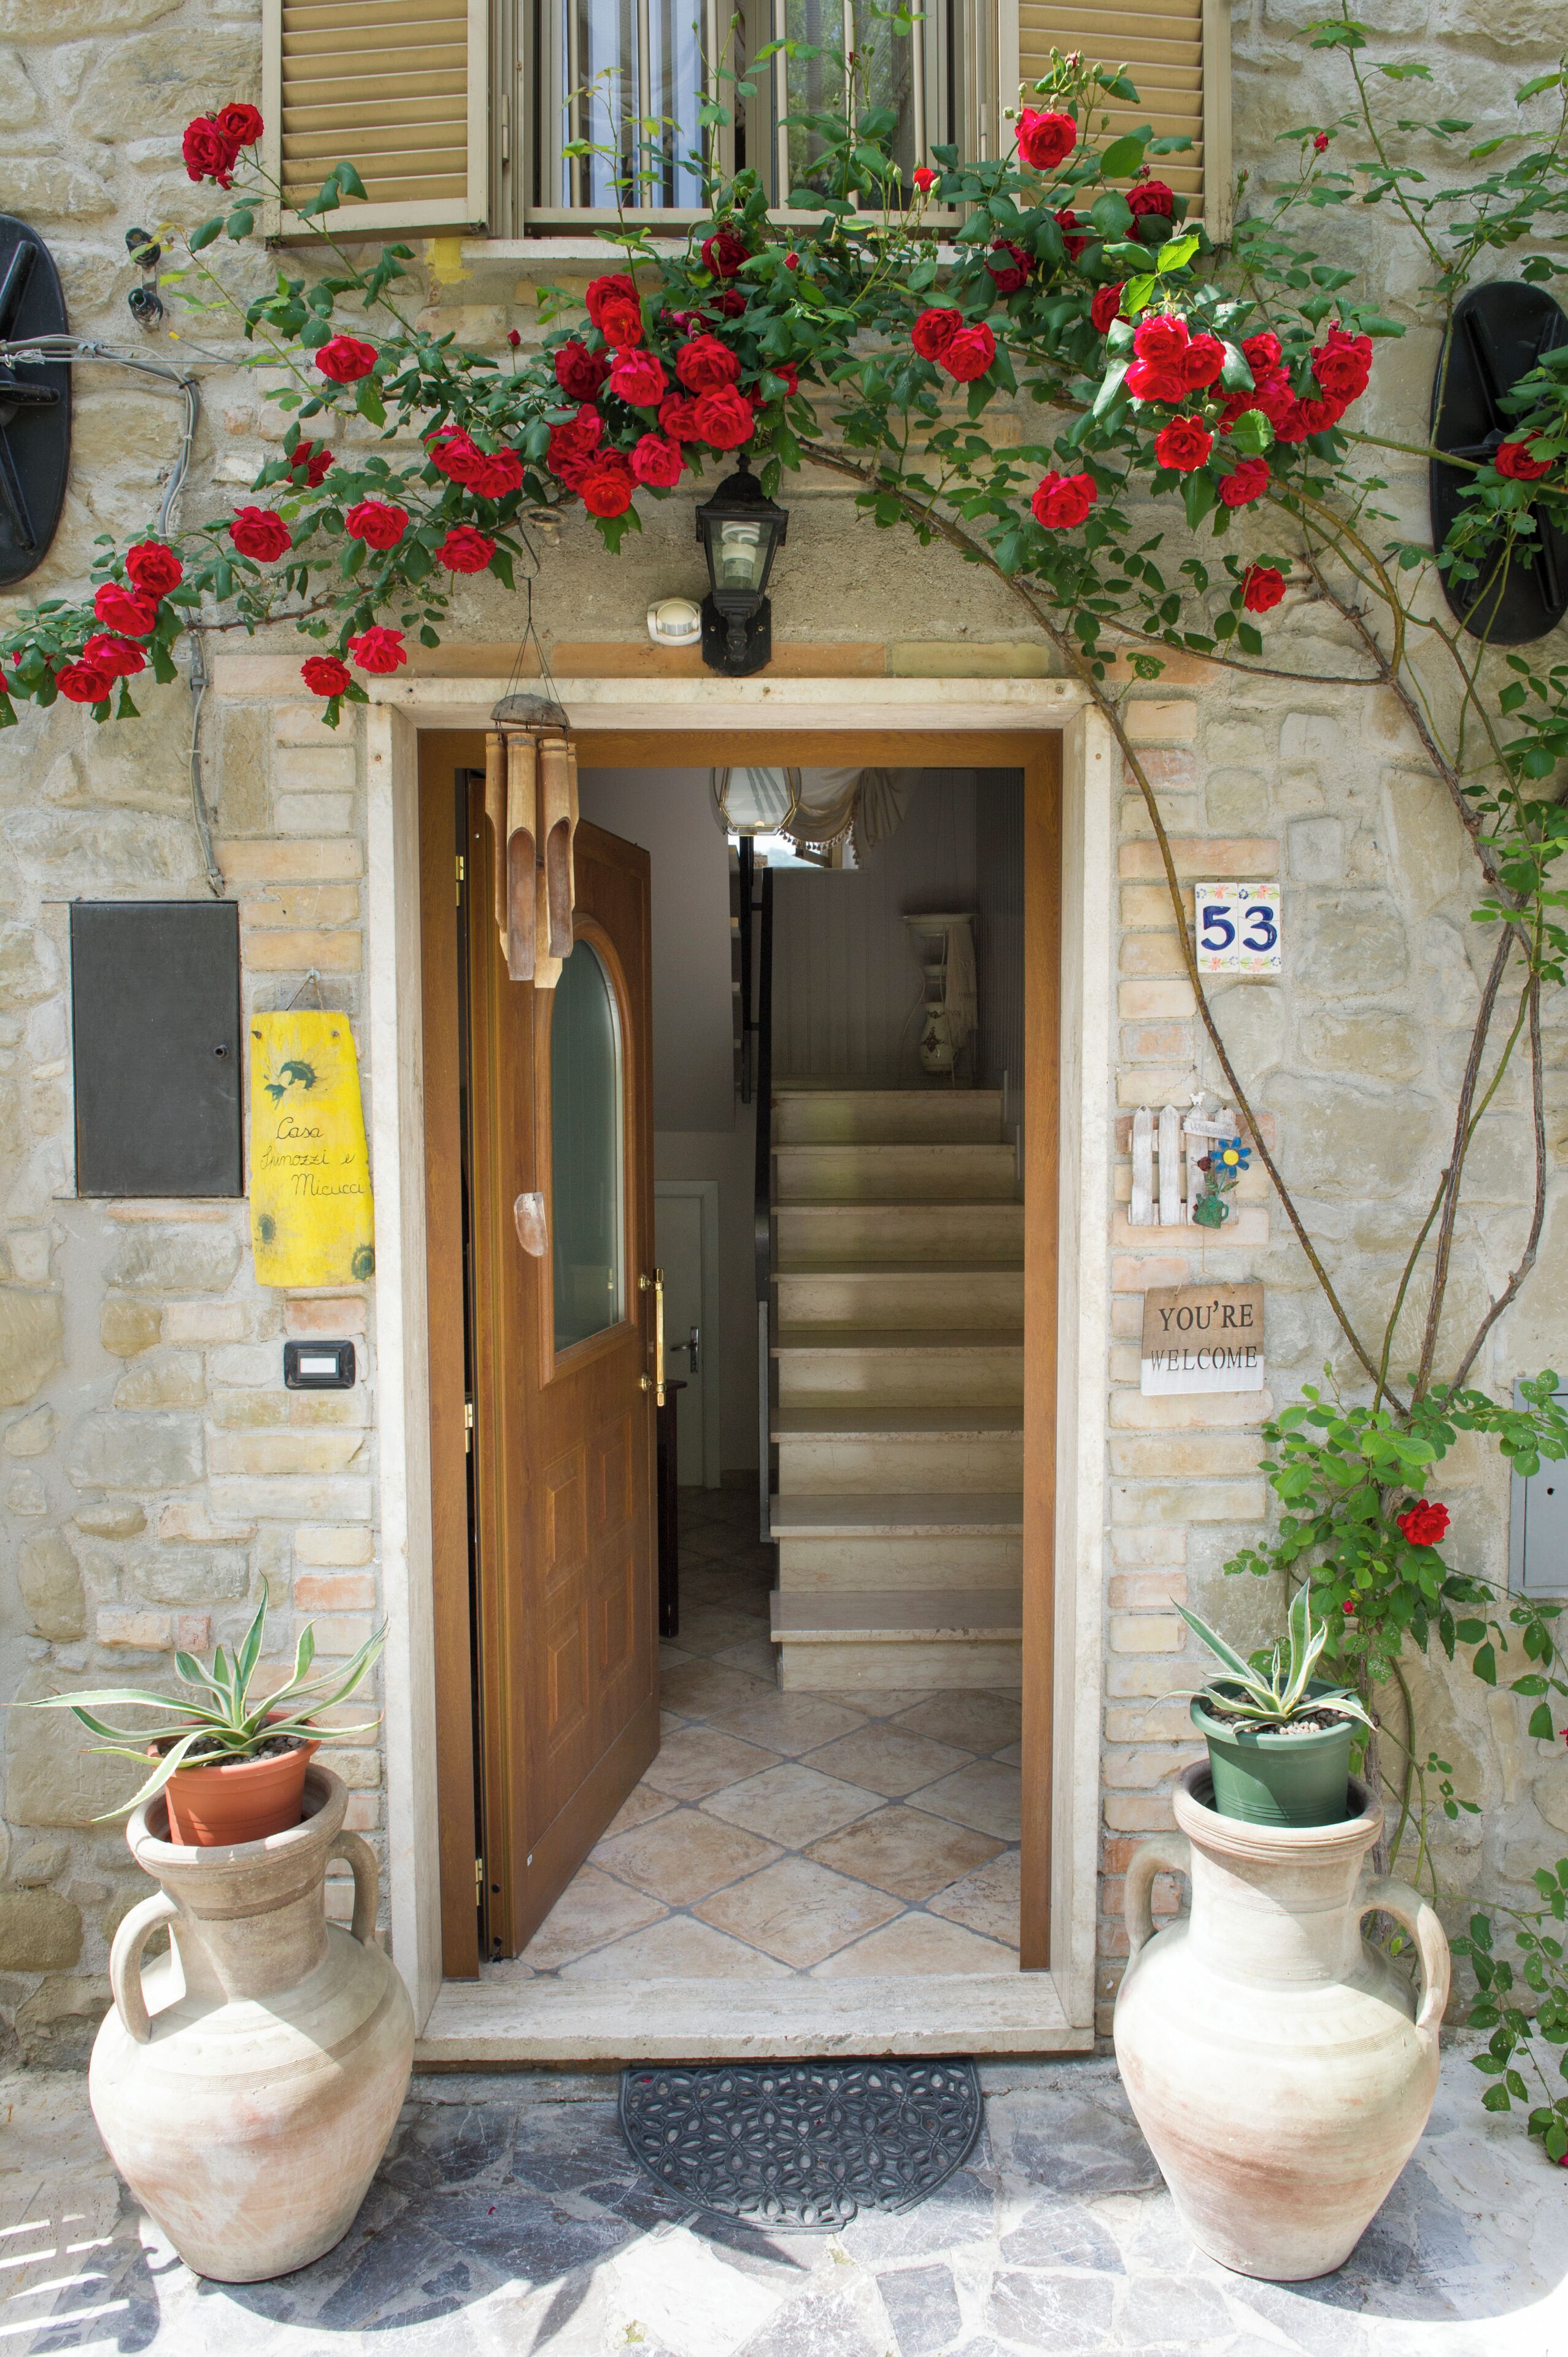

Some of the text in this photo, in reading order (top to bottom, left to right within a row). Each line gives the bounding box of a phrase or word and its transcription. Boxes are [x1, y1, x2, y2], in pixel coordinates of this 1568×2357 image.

[1201, 905, 1278, 952] 53
[276, 1117, 324, 1140] Casa
[291, 1173, 365, 1196] Micucci
[1158, 1300, 1254, 1331] YOU'RE
[1151, 1345, 1258, 1371] WELCOME
